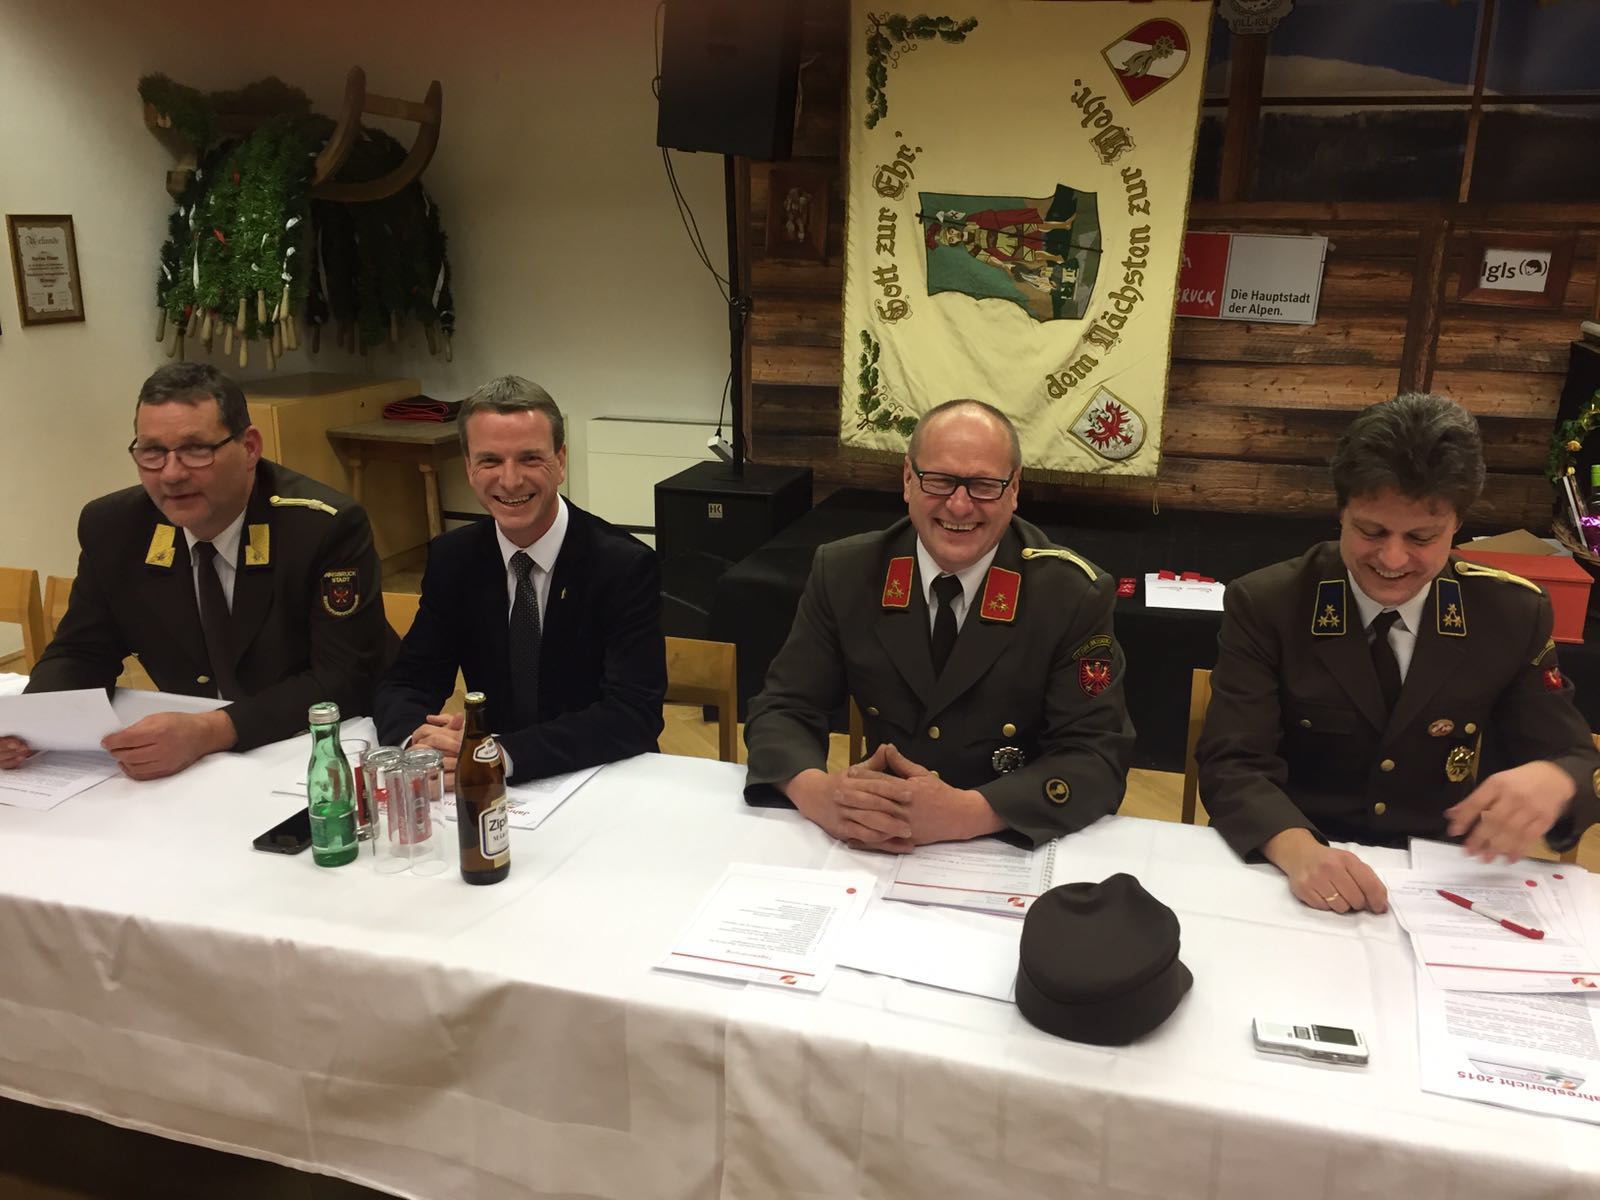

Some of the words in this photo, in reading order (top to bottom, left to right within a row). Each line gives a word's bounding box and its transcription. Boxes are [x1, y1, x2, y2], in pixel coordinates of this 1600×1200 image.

[875, 206, 897, 257] zur
[1481, 261, 1516, 282] Igls
[1046, 354, 1098, 400] dem
[1120, 166, 1151, 216] zur
[1230, 289, 1248, 300] Die
[1251, 291, 1311, 304] Hauptstadt
[1228, 302, 1247, 313] der
[1248, 303, 1283, 317] Alpen.
[1457, 1070, 1495, 1083] 2015
